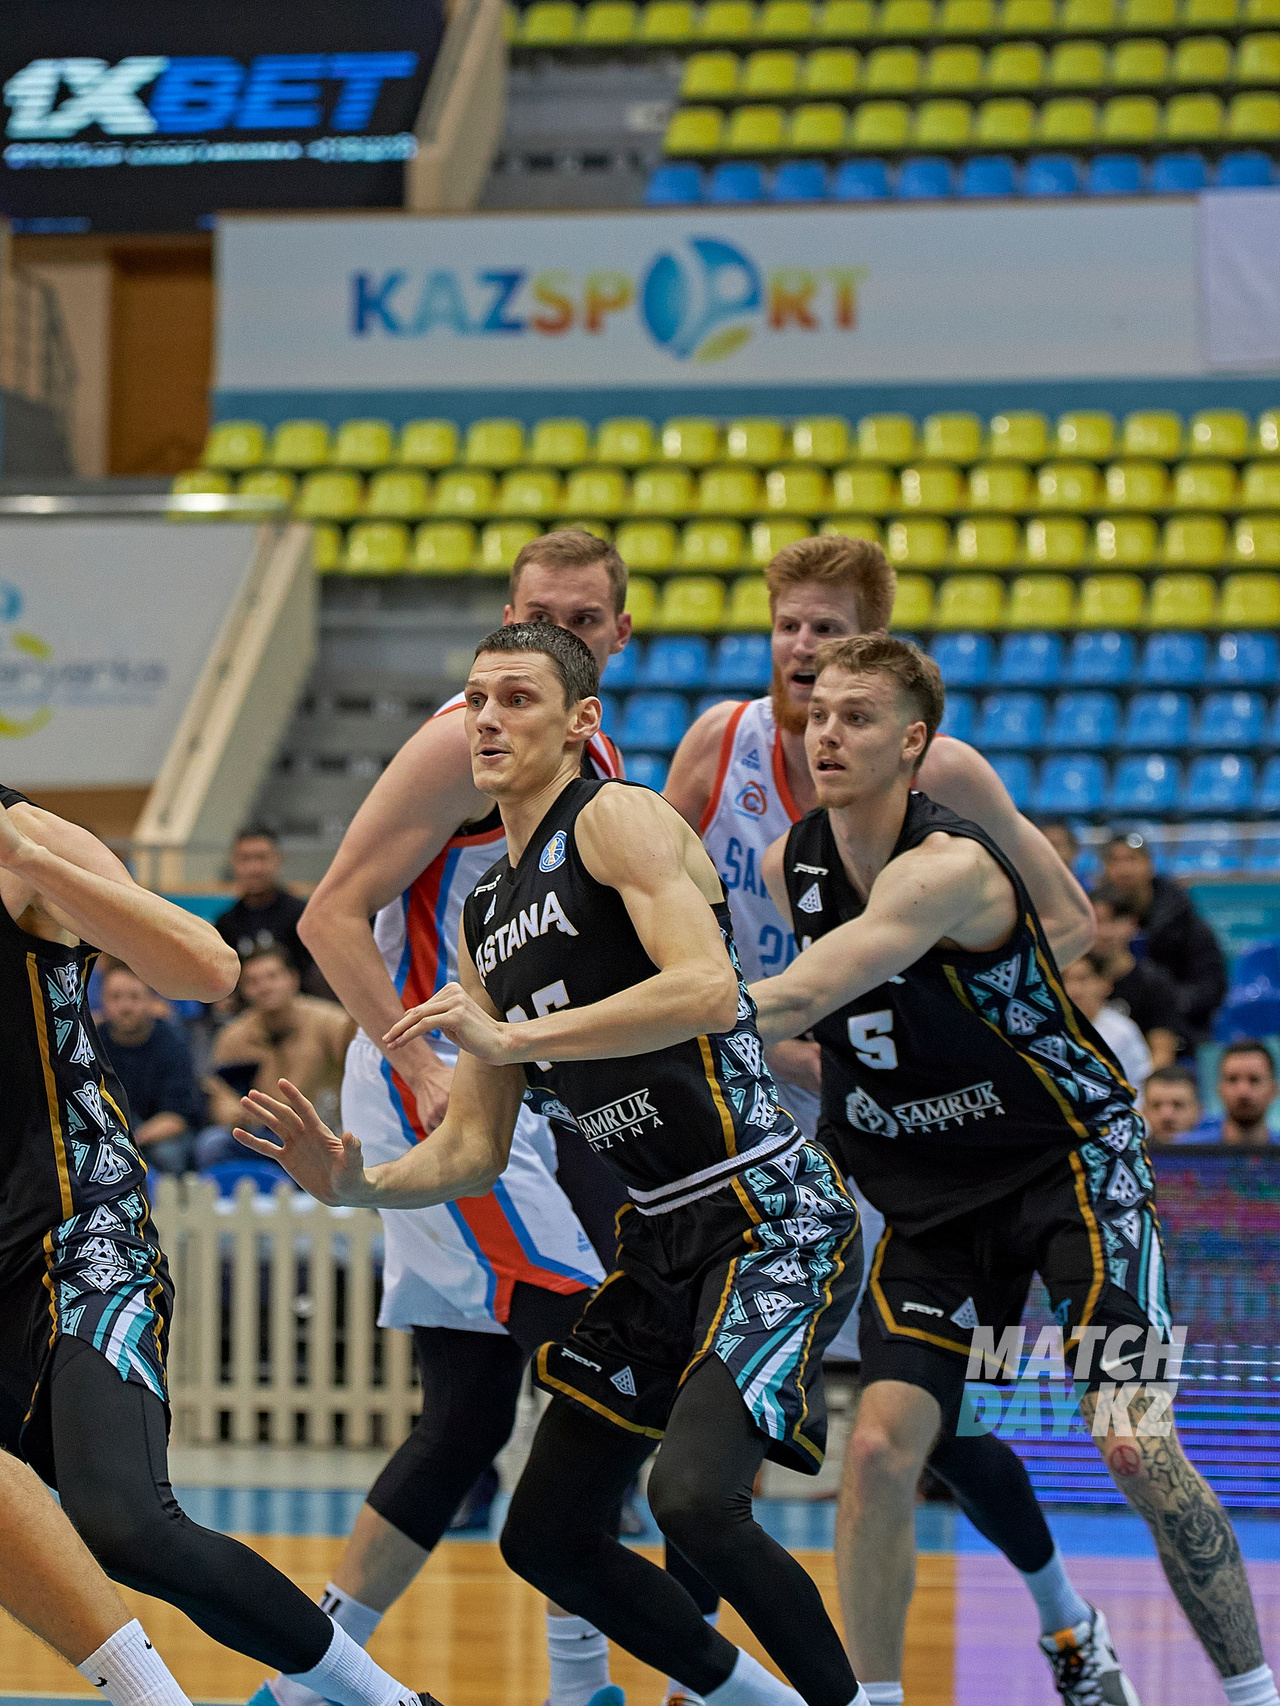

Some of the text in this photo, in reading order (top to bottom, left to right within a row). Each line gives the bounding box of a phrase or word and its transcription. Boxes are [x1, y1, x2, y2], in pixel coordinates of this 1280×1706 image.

[4, 52, 418, 138] 1XBET
[475, 890, 580, 988] ASTANA
[847, 1009, 899, 1071] 5
[894, 1084, 1001, 1127] SAMRUK
[903, 1105, 1006, 1135] KAZYNA
